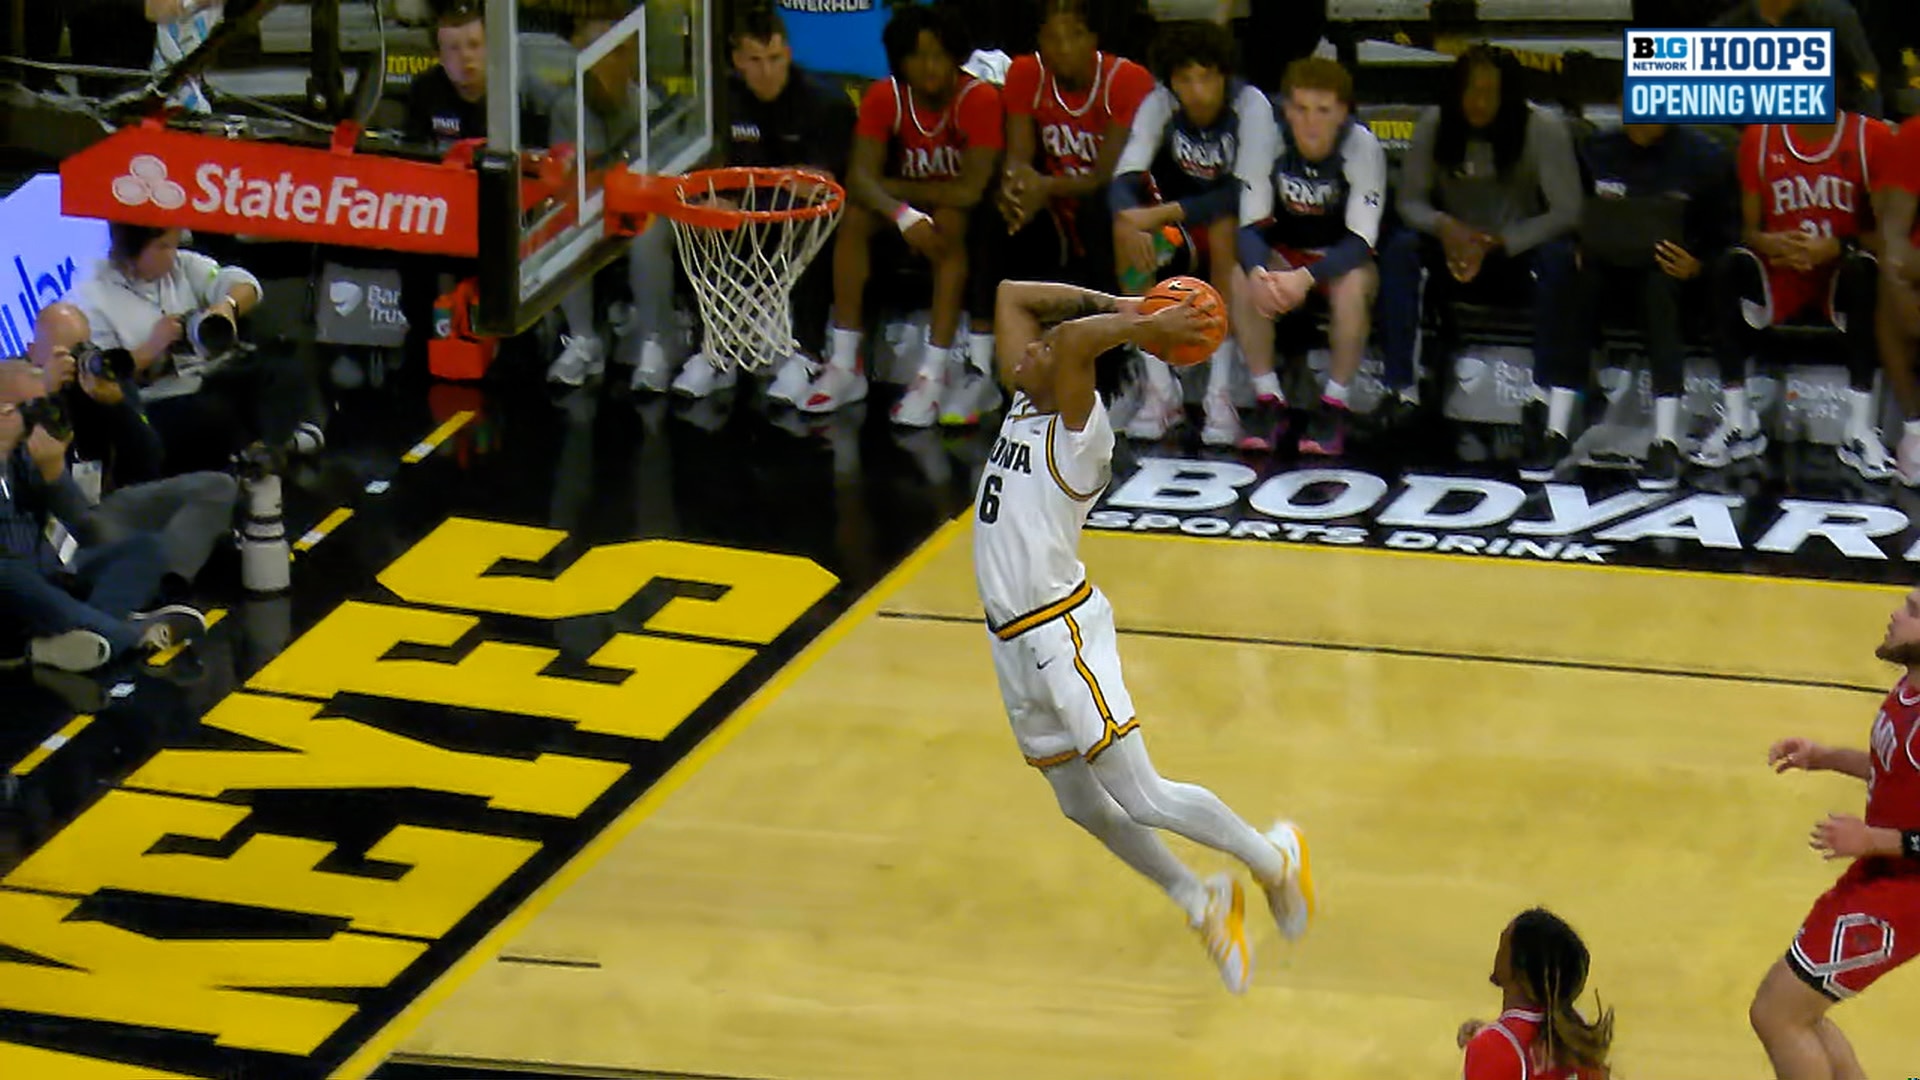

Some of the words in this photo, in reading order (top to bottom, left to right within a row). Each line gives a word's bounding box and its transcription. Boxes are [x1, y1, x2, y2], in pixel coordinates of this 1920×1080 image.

[1771, 173, 1855, 216] RMU
[979, 474, 1003, 525] 6
[1106, 457, 1920, 562] BODYAR
[1085, 511, 1370, 544] SPORTS
[1384, 530, 1618, 563] DRINK
[0, 516, 840, 1080] KEYES
